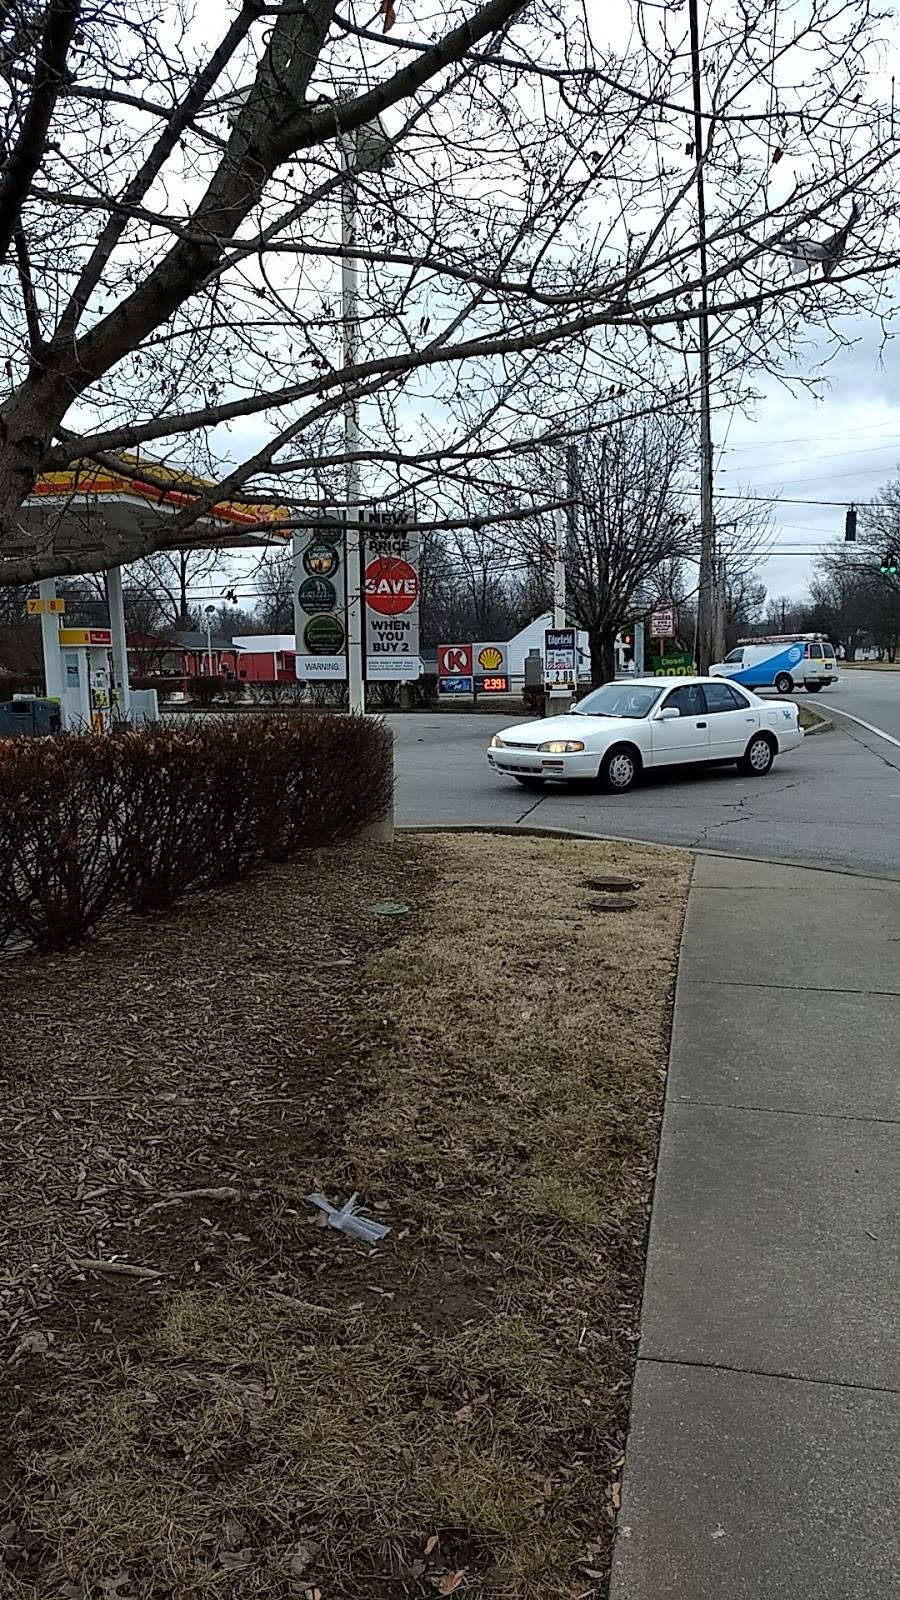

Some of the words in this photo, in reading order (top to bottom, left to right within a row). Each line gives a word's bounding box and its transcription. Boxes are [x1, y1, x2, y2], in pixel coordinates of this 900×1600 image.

[369, 513, 408, 524] NEW
[369, 541, 410, 551] PRICE
[365, 578, 417, 594] SAVE
[30, 602, 36, 612] 7
[50, 601, 56, 610] 8
[371, 620, 411, 631] WHEN
[378, 632, 404, 641] YOU
[373, 643, 398, 652] BUY
[401, 643, 410, 652] 2
[661, 656, 685, 666] Diesel
[305, 663, 341, 671] WARNING:
